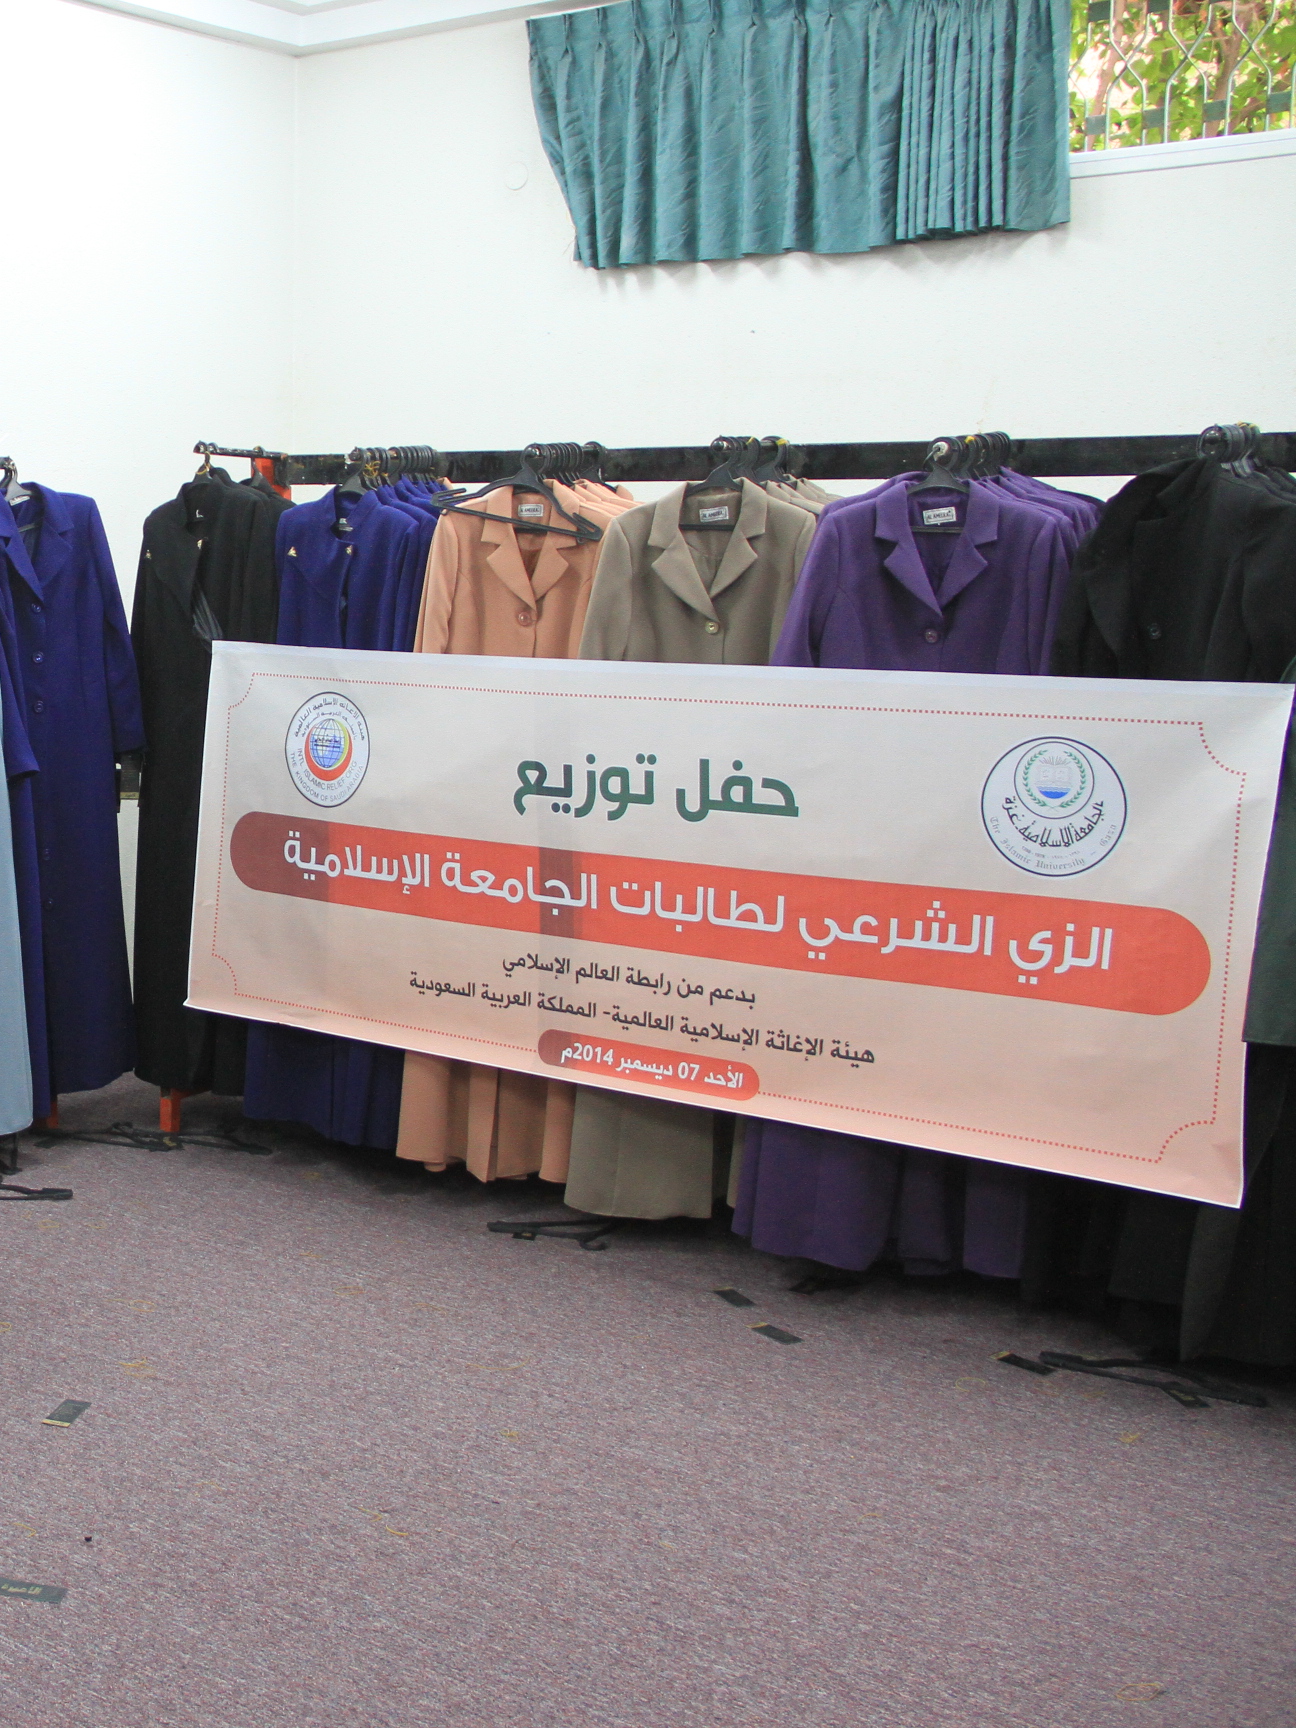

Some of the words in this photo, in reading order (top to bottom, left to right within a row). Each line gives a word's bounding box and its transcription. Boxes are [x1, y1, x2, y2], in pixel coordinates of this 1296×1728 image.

[295, 770, 319, 799] KINGDOM
[320, 793, 328, 801] OF
[326, 776, 344, 791] RELIEF
[513, 753, 657, 821] توزيع
[675, 758, 799, 822] حفل
[283, 830, 430, 894] الإسلامية
[440, 851, 598, 916] الجامعة
[610, 881, 785, 933] لطالبات
[799, 900, 994, 961] الشرعي
[502, 953, 570, 979] الإسلامي
[1008, 923, 1113, 985] الزي
[410, 971, 476, 997] السعودية
[575, 962, 620, 984] العالم
[625, 967, 671, 996] رابطة
[481, 983, 532, 1008] العربية
[676, 977, 704, 999] من
[709, 986, 756, 1010] بدعم
[537, 992, 597, 1018] المملكة
[680, 1016, 759, 1051] الإسلامية
[765, 1029, 824, 1061] الإغاثة
[615, 1055, 673, 1080] ديسمبر
[830, 1039, 875, 1068] هيئة
[677, 1061, 700, 1081] 07
[704, 1066, 743, 1088] الأحد
